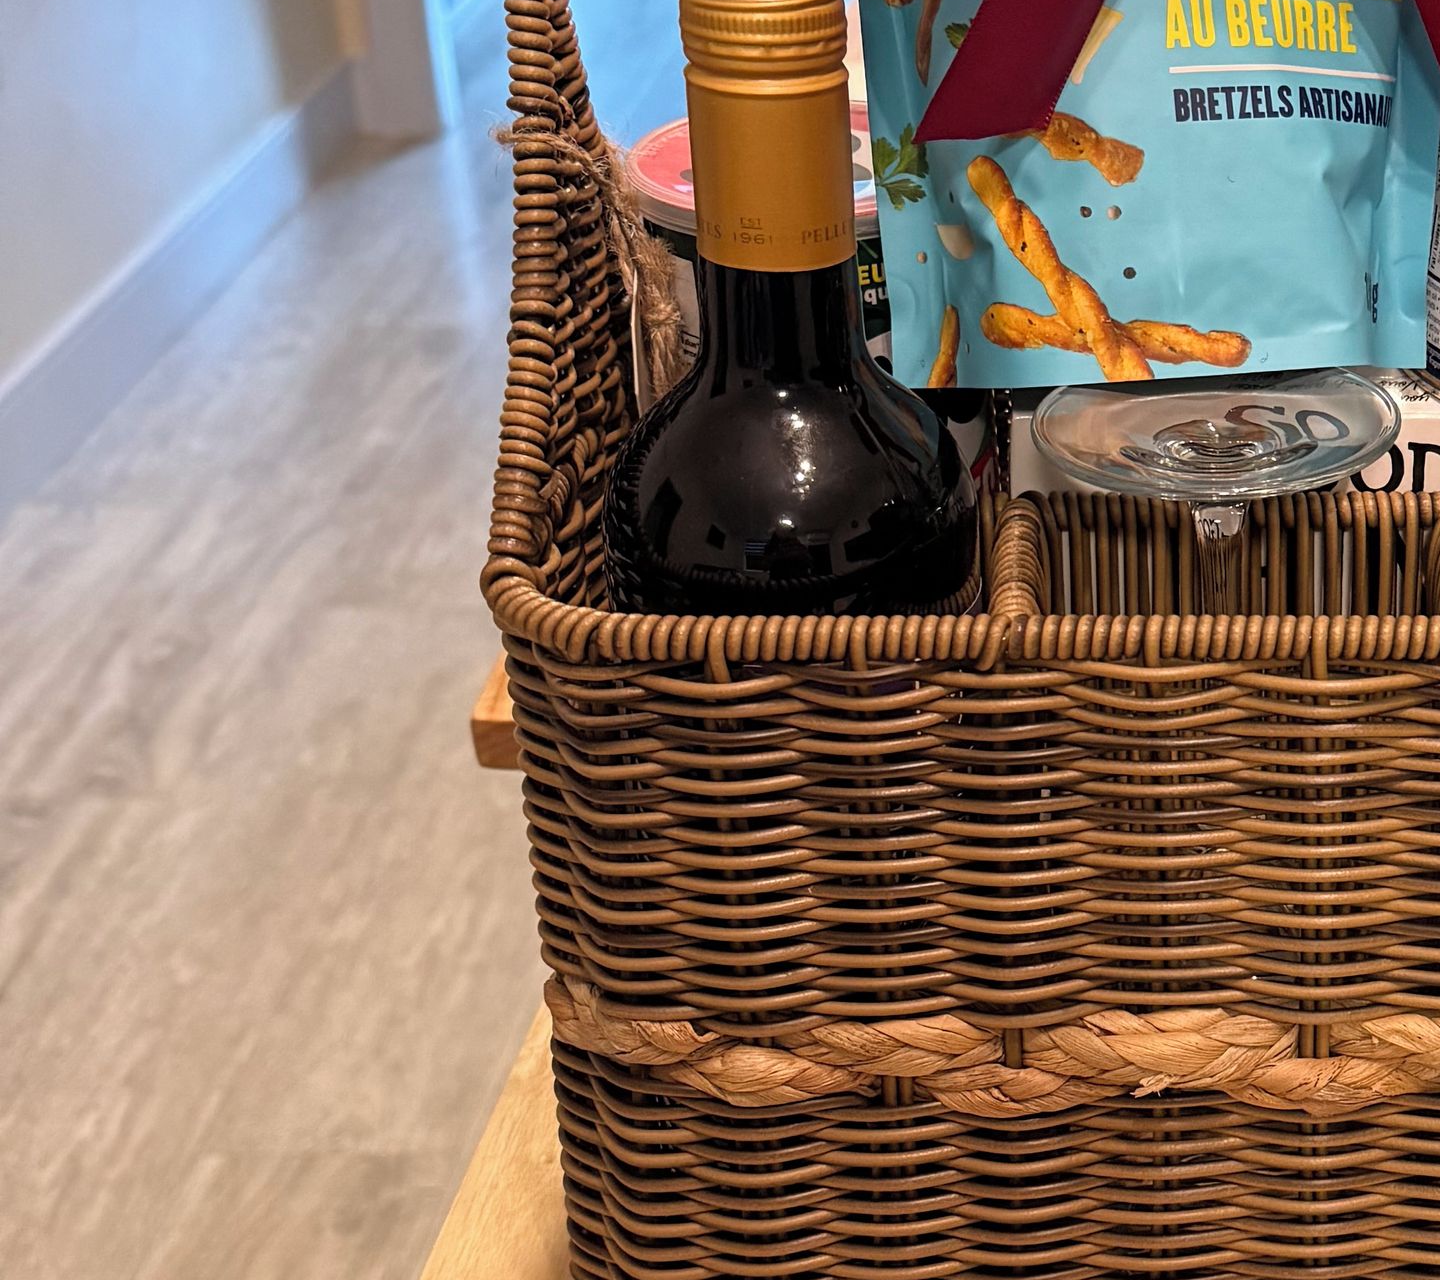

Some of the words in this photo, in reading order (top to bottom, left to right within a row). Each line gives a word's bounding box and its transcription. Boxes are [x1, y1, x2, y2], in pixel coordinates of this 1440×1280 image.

[1173, 85, 1293, 123] BRETZELS
[1299, 86, 1393, 128] ARTISANAU
[733, 232, 773, 246] 1961
